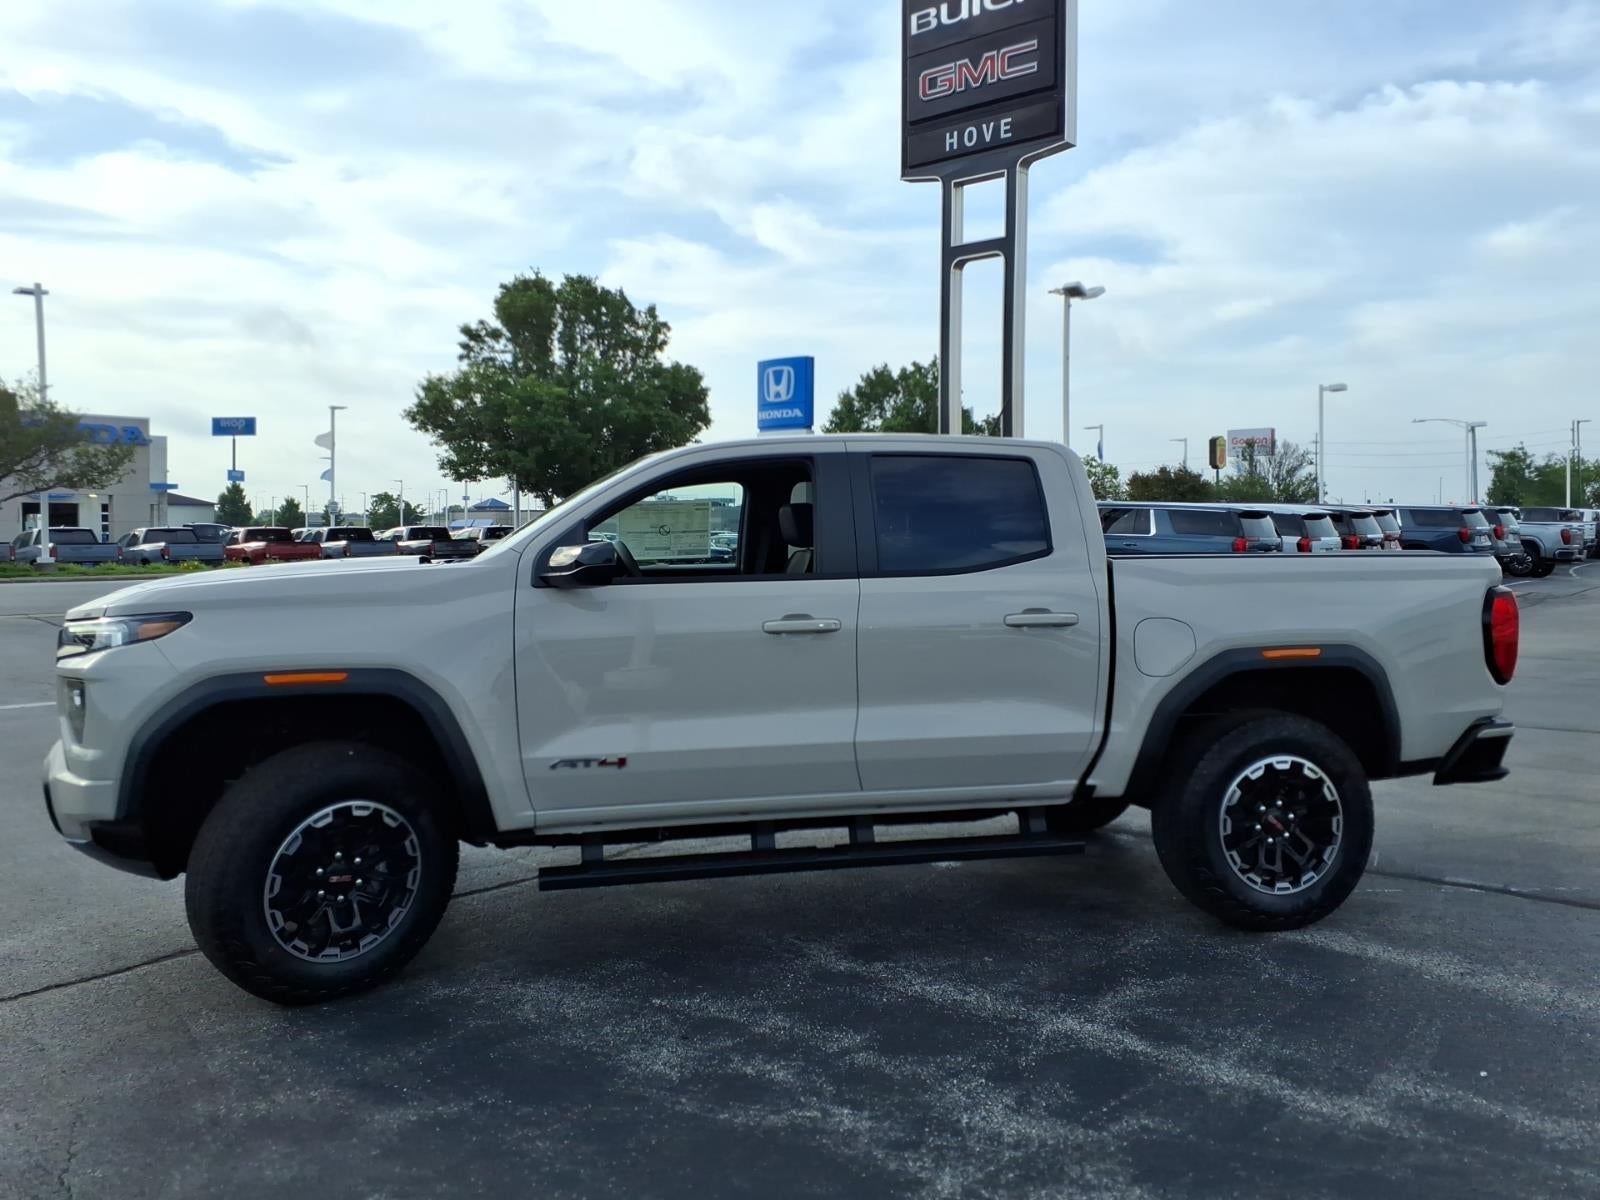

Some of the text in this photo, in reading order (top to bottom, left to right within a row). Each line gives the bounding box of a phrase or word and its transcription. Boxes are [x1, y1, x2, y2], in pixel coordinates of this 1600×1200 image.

[910, 0, 1025, 36] BUIC
[918, 39, 1039, 102] GMC
[945, 117, 1013, 152] HOVE
[758, 408, 804, 420] HONDA
[549, 757, 627, 770] AT4
